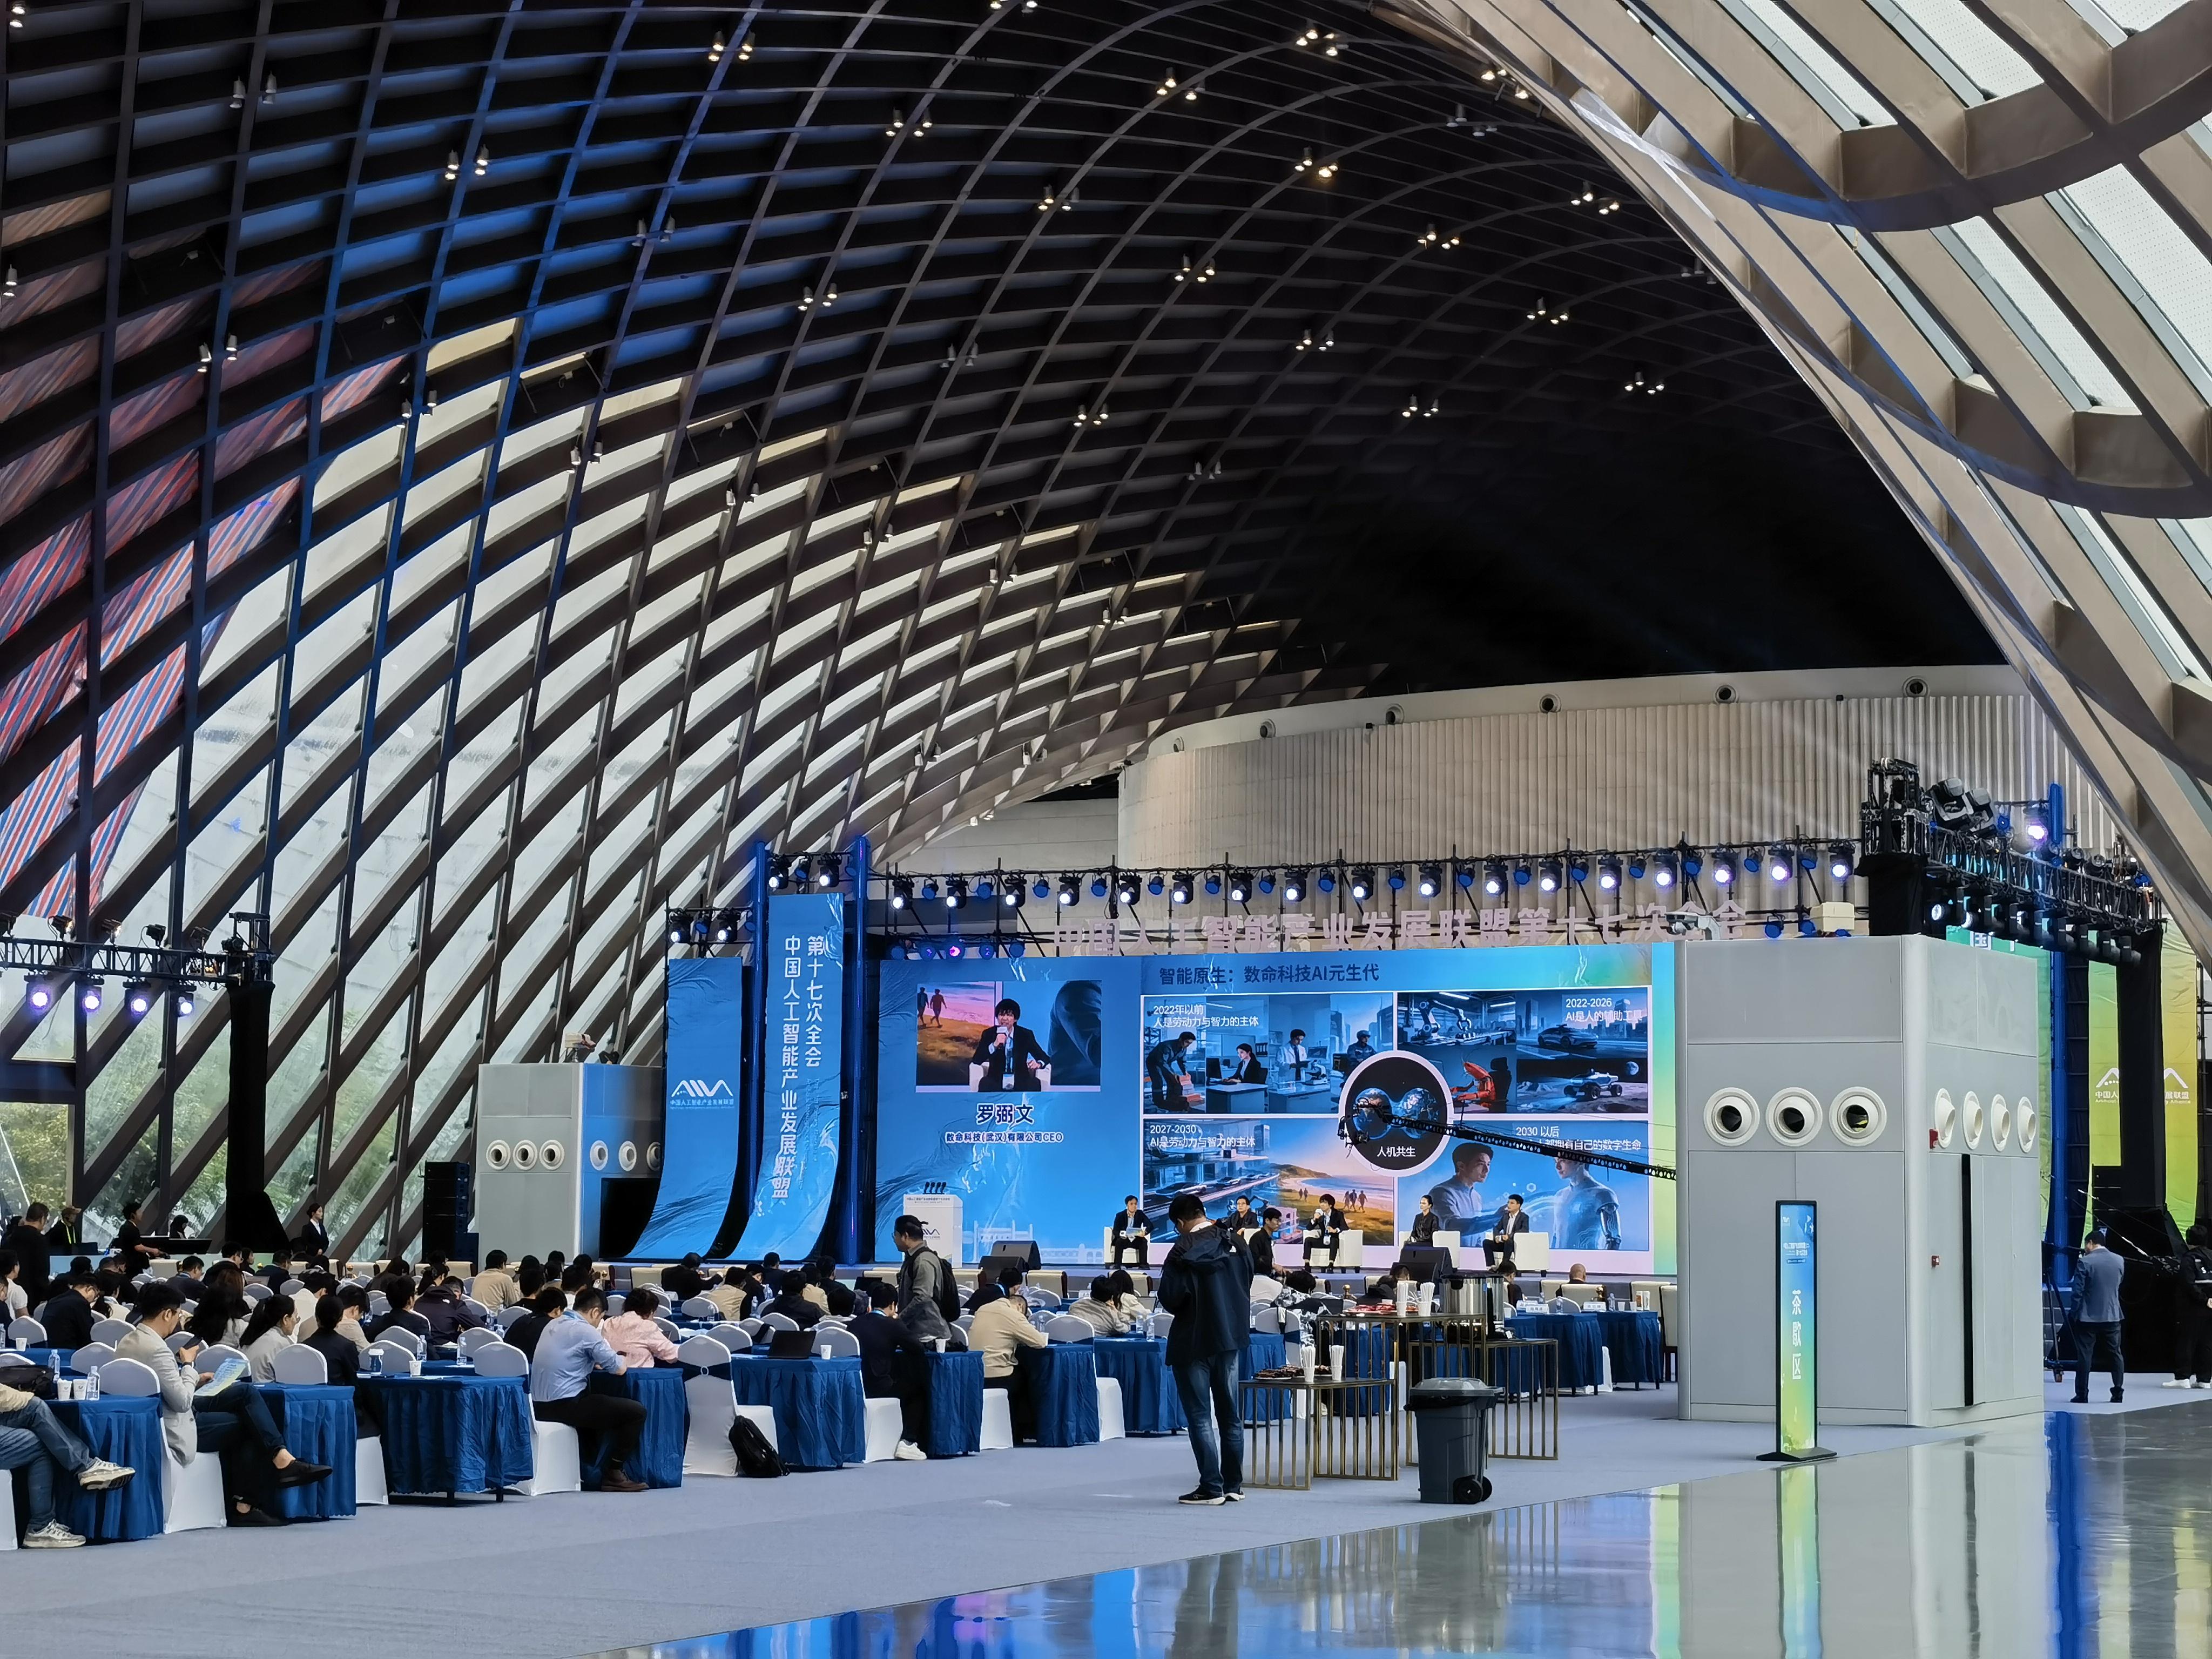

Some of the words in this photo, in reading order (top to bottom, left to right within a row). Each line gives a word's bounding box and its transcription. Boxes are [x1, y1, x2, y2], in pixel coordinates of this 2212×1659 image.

[804, 935, 825, 1068] 第十七次全会
[1566, 997, 1612, 1008] 2022-2026
[1153, 1004, 1204, 1015] 2022年以前
[1566, 1009, 1642, 1022] AI是人的辅助工具
[1153, 1016, 1259, 1028] 人是劳动力与智力的主体
[771, 935, 801, 1198] 中国人工智能产业发展联盟
[976, 1103, 1034, 1124] 罗弼文
[1150, 1124, 1197, 1134] 2027-2030
[1516, 1127, 1538, 1136] 2030
[1540, 1125, 1560, 1138] 以后
[1150, 1136, 1256, 1148] AI是劳动力与智力的主体
[1529, 1138, 1642, 1151] 都拥有自己的数字生命
[1377, 1146, 1416, 1157] 人机共生
[1791, 1289, 1802, 1380] 茶歇区
